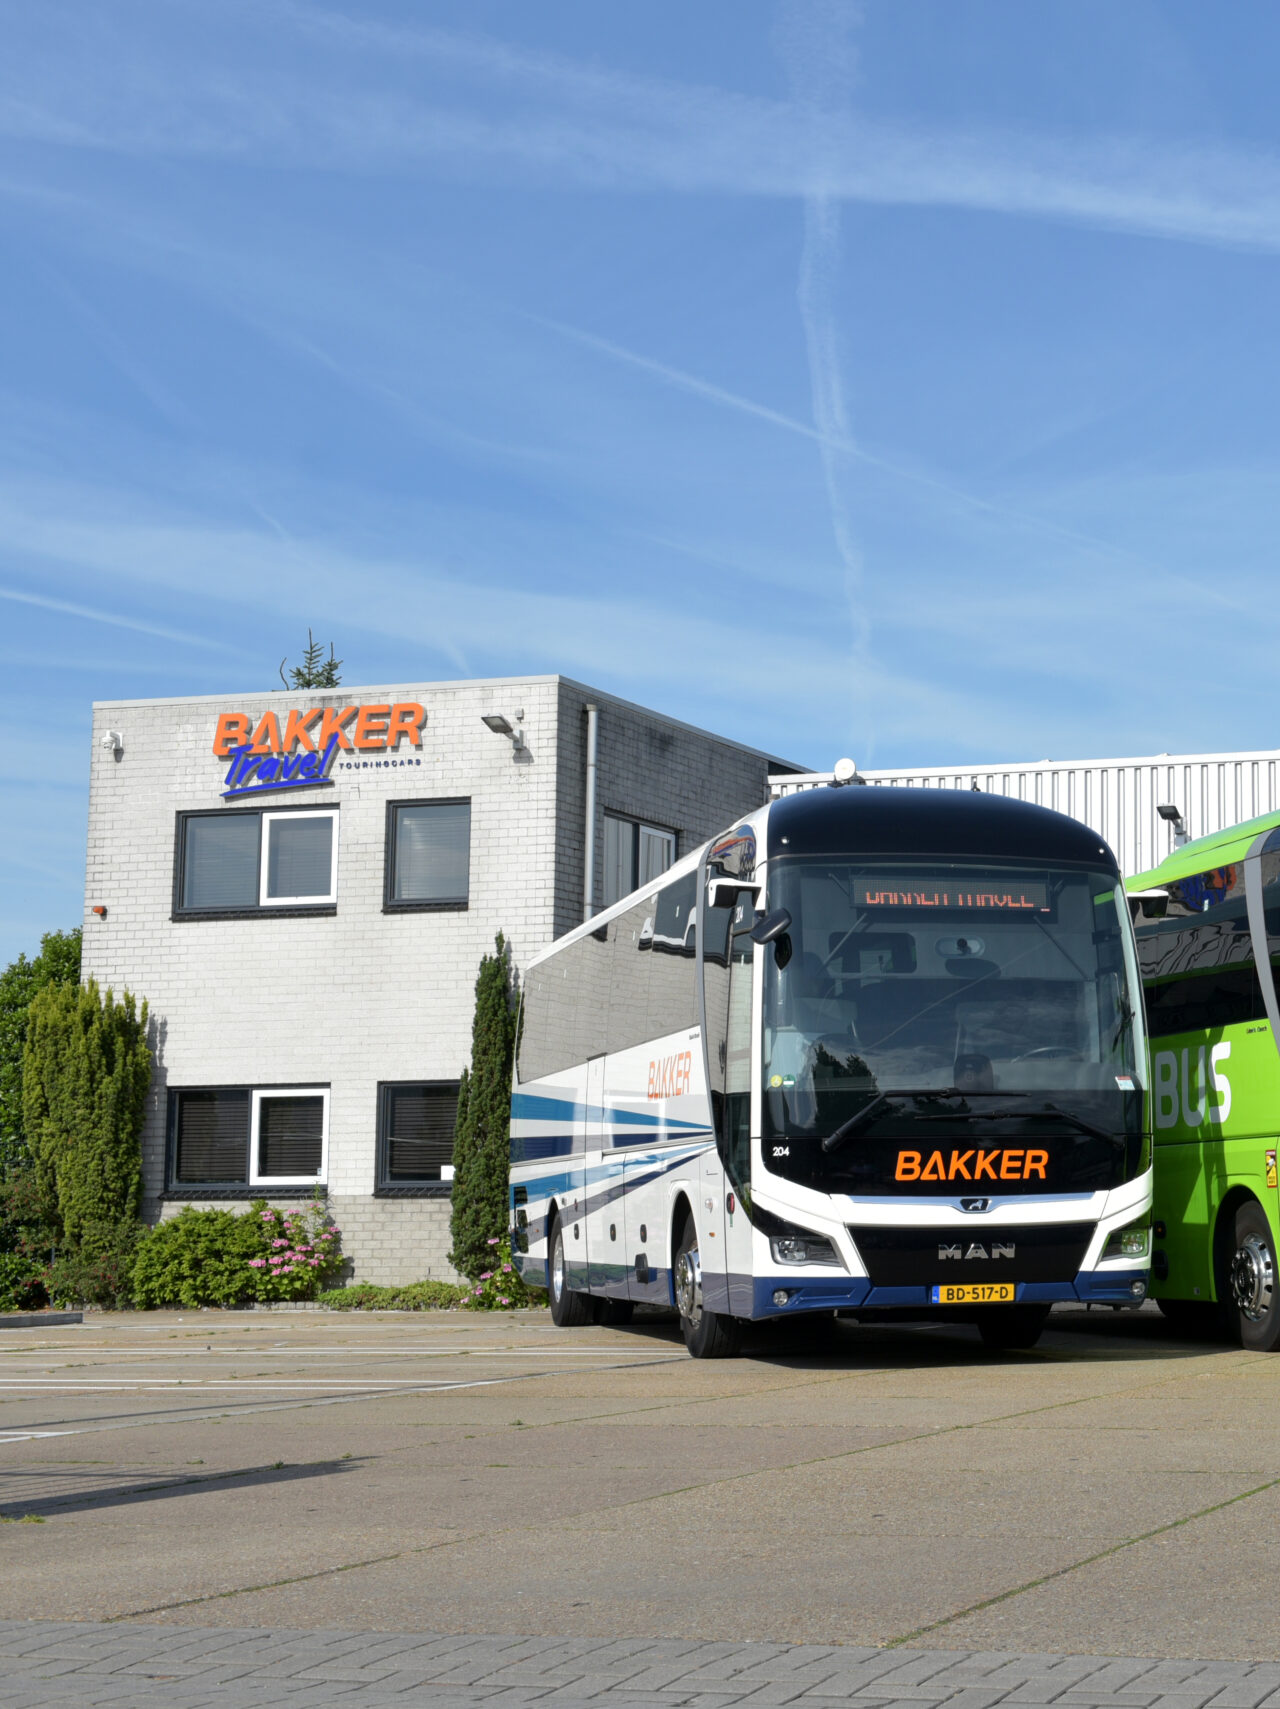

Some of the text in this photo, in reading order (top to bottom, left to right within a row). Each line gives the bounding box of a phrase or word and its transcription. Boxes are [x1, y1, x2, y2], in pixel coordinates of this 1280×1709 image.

[212, 702, 425, 756] BAKKER
[224, 731, 340, 786] Travel
[338, 758, 421, 770] TOURINGCARS
[647, 1050, 692, 1100] BAKKER
[772, 1146, 790, 1157] 204
[894, 1149, 1049, 1181] BAKKER
[938, 1243, 1016, 1260] MAN
[946, 1286, 1009, 1301] BD-517-D
